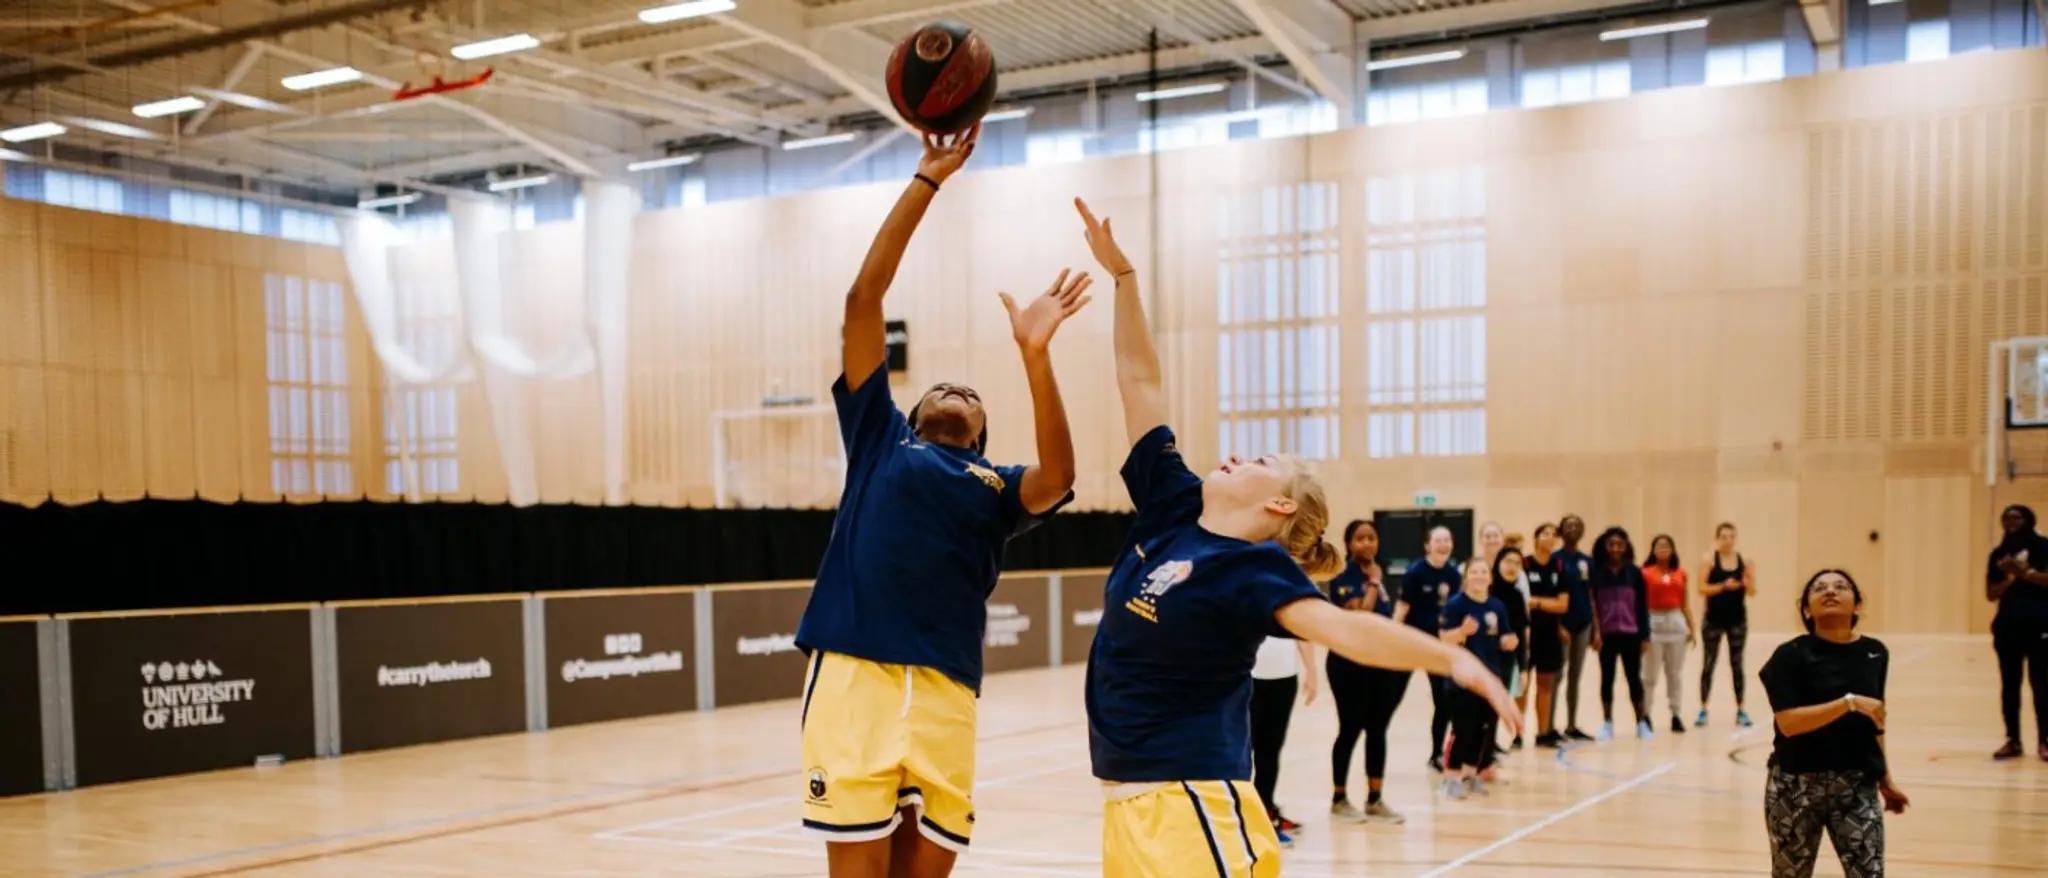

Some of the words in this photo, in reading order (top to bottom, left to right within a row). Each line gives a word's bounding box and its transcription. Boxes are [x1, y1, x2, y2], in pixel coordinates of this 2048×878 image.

[378, 656, 491, 687] #carrythetorch
[142, 679, 255, 708] UNIVERSITY
[143, 707, 170, 730] OF
[173, 703, 225, 728] HULL
